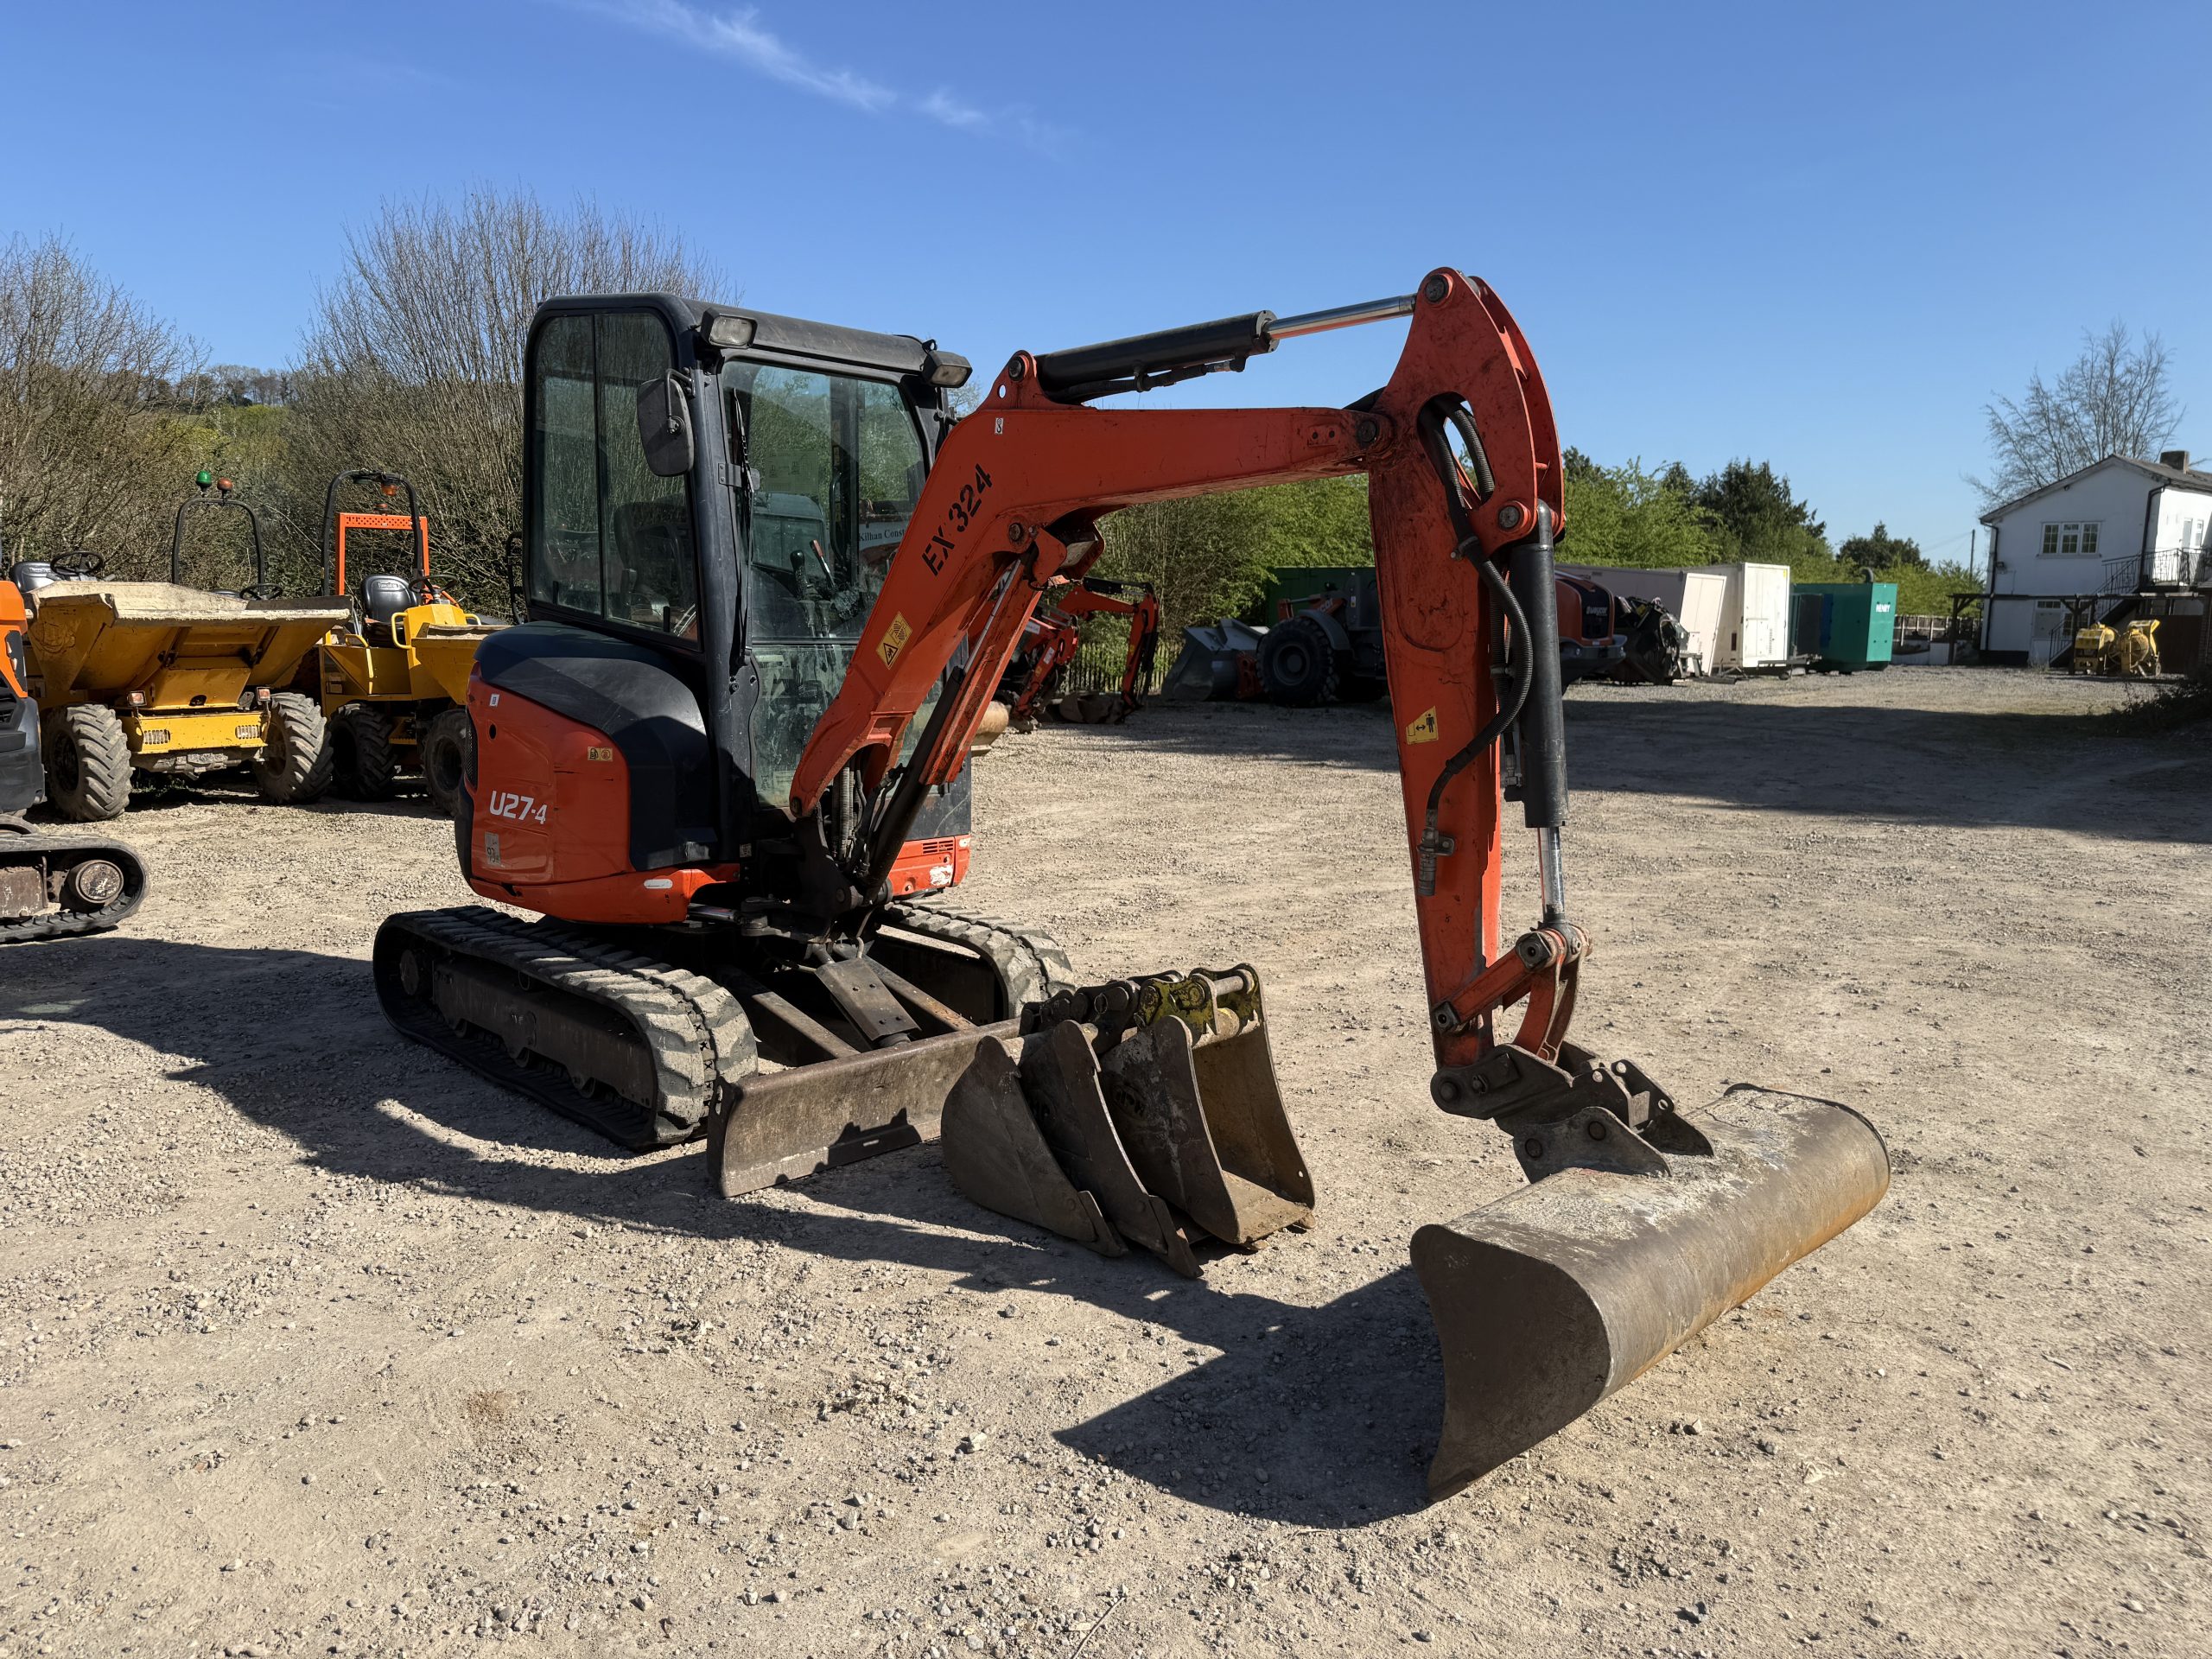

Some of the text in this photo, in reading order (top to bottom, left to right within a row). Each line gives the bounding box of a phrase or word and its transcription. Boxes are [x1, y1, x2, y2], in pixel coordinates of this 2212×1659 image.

[922, 463, 992, 576] EX 324
[489, 790, 548, 825] U27-4
